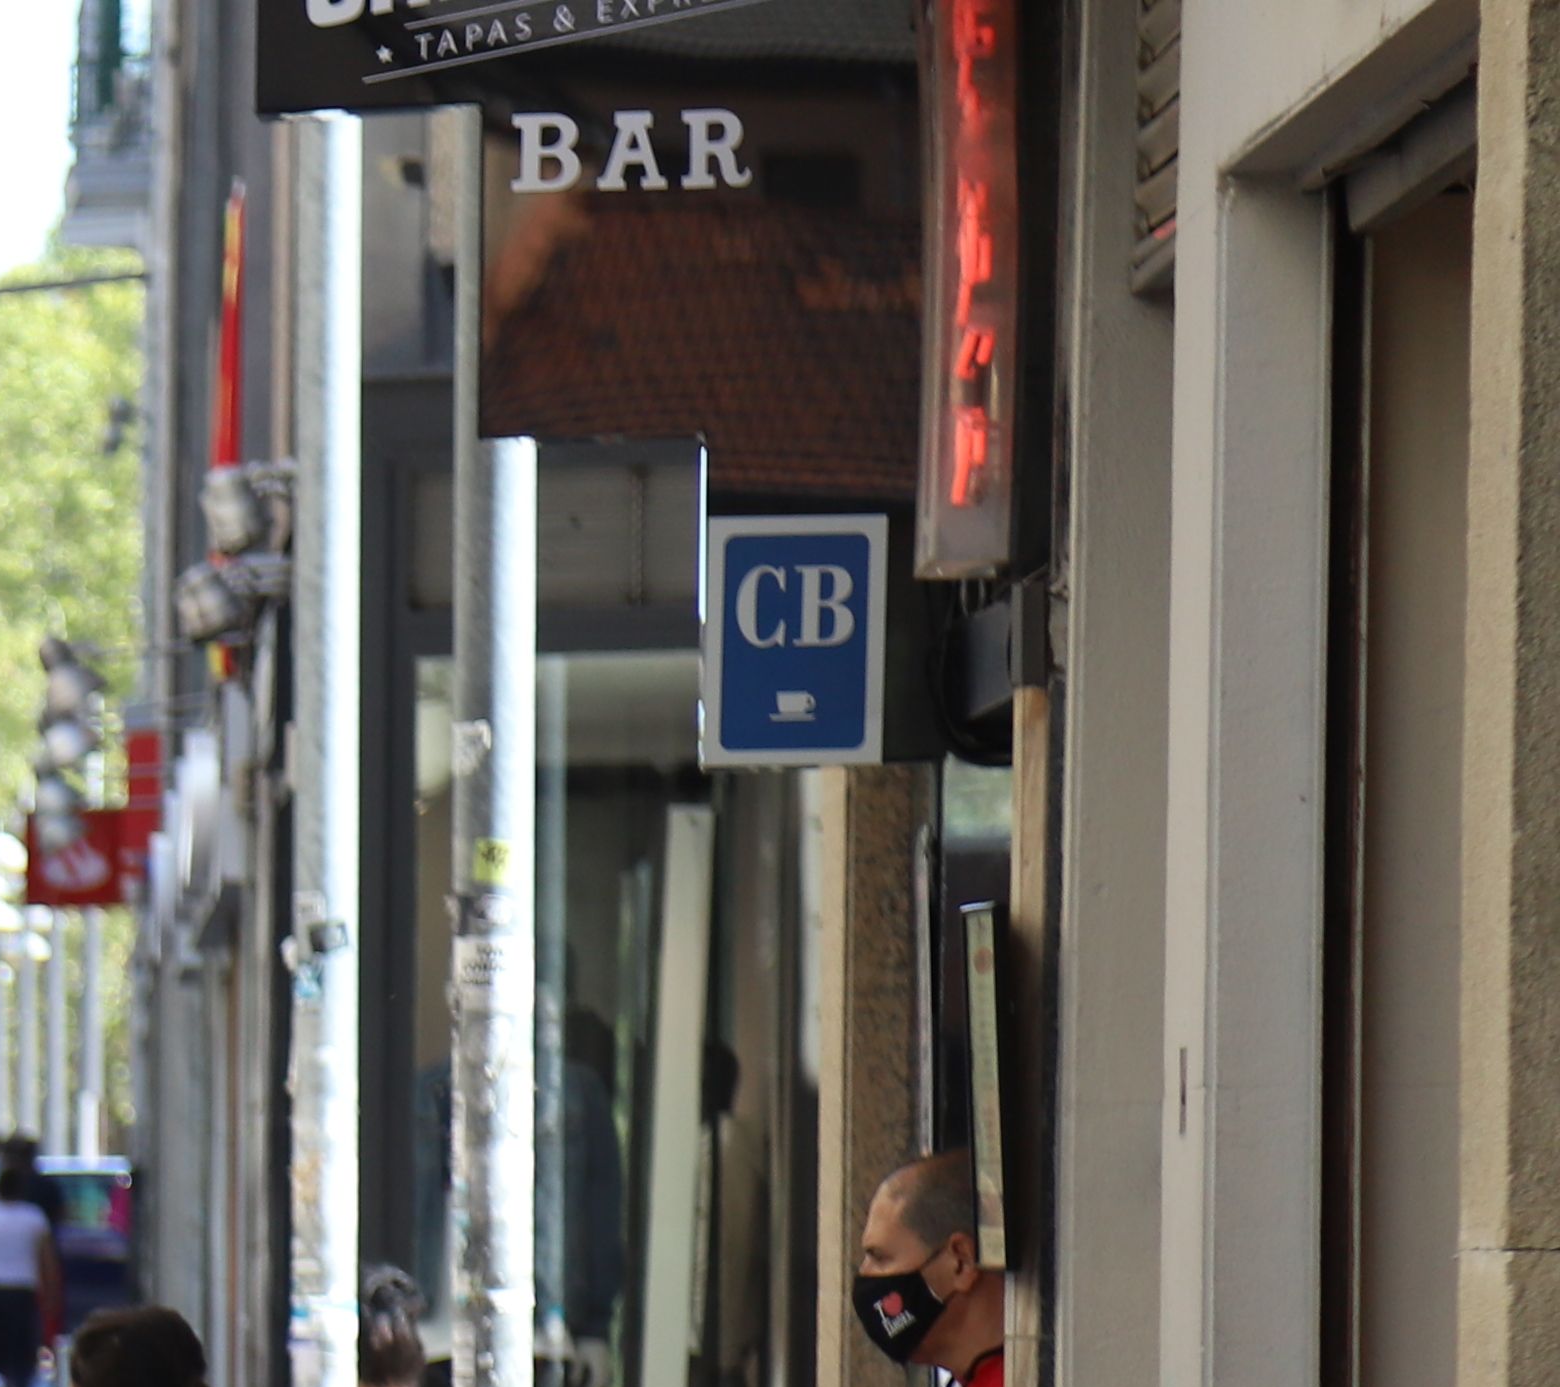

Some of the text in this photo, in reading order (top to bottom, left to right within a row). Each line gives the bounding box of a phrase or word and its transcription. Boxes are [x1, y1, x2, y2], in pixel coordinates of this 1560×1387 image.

[415, 12, 533, 63] TAPAS
[551, 3, 577, 33] &
[510, 107, 753, 193] BAR
[735, 564, 856, 648] CB
